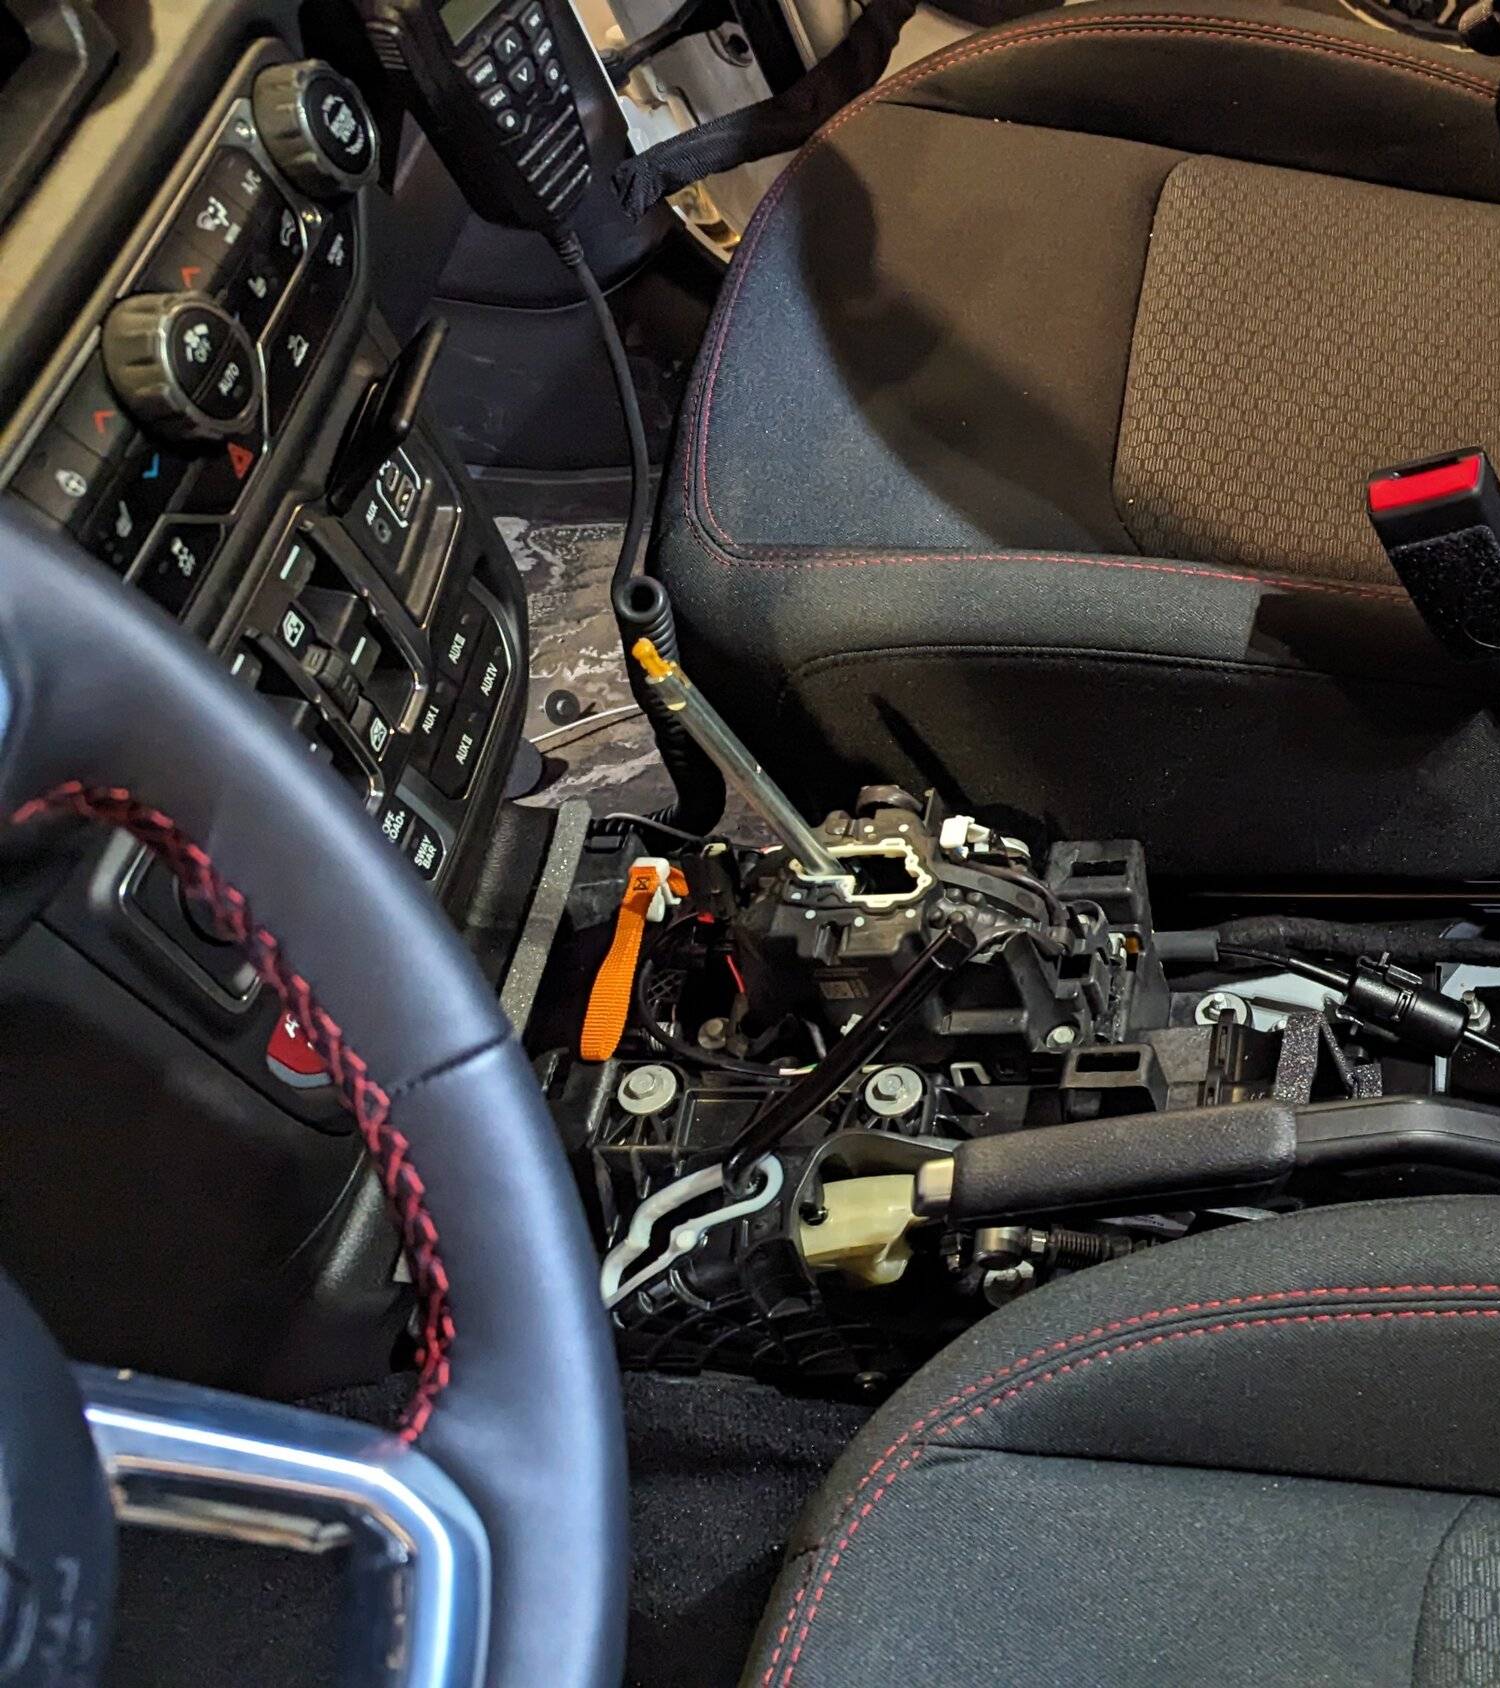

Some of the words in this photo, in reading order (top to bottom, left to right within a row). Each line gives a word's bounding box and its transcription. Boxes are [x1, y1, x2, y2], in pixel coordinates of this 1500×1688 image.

[218, 361, 240, 397] AUTO
[365, 499, 379, 526] AUX
[448, 643, 463, 665] AUX
[480, 671, 495, 696] AUX
[422, 711, 436, 734] AUX
[455, 744, 470, 765] AUX
[382, 809, 395, 834] OFF
[388, 810, 406, 843] OAD+
[414, 834, 431, 867] SWAY
[421, 844, 437, 870] BAR
